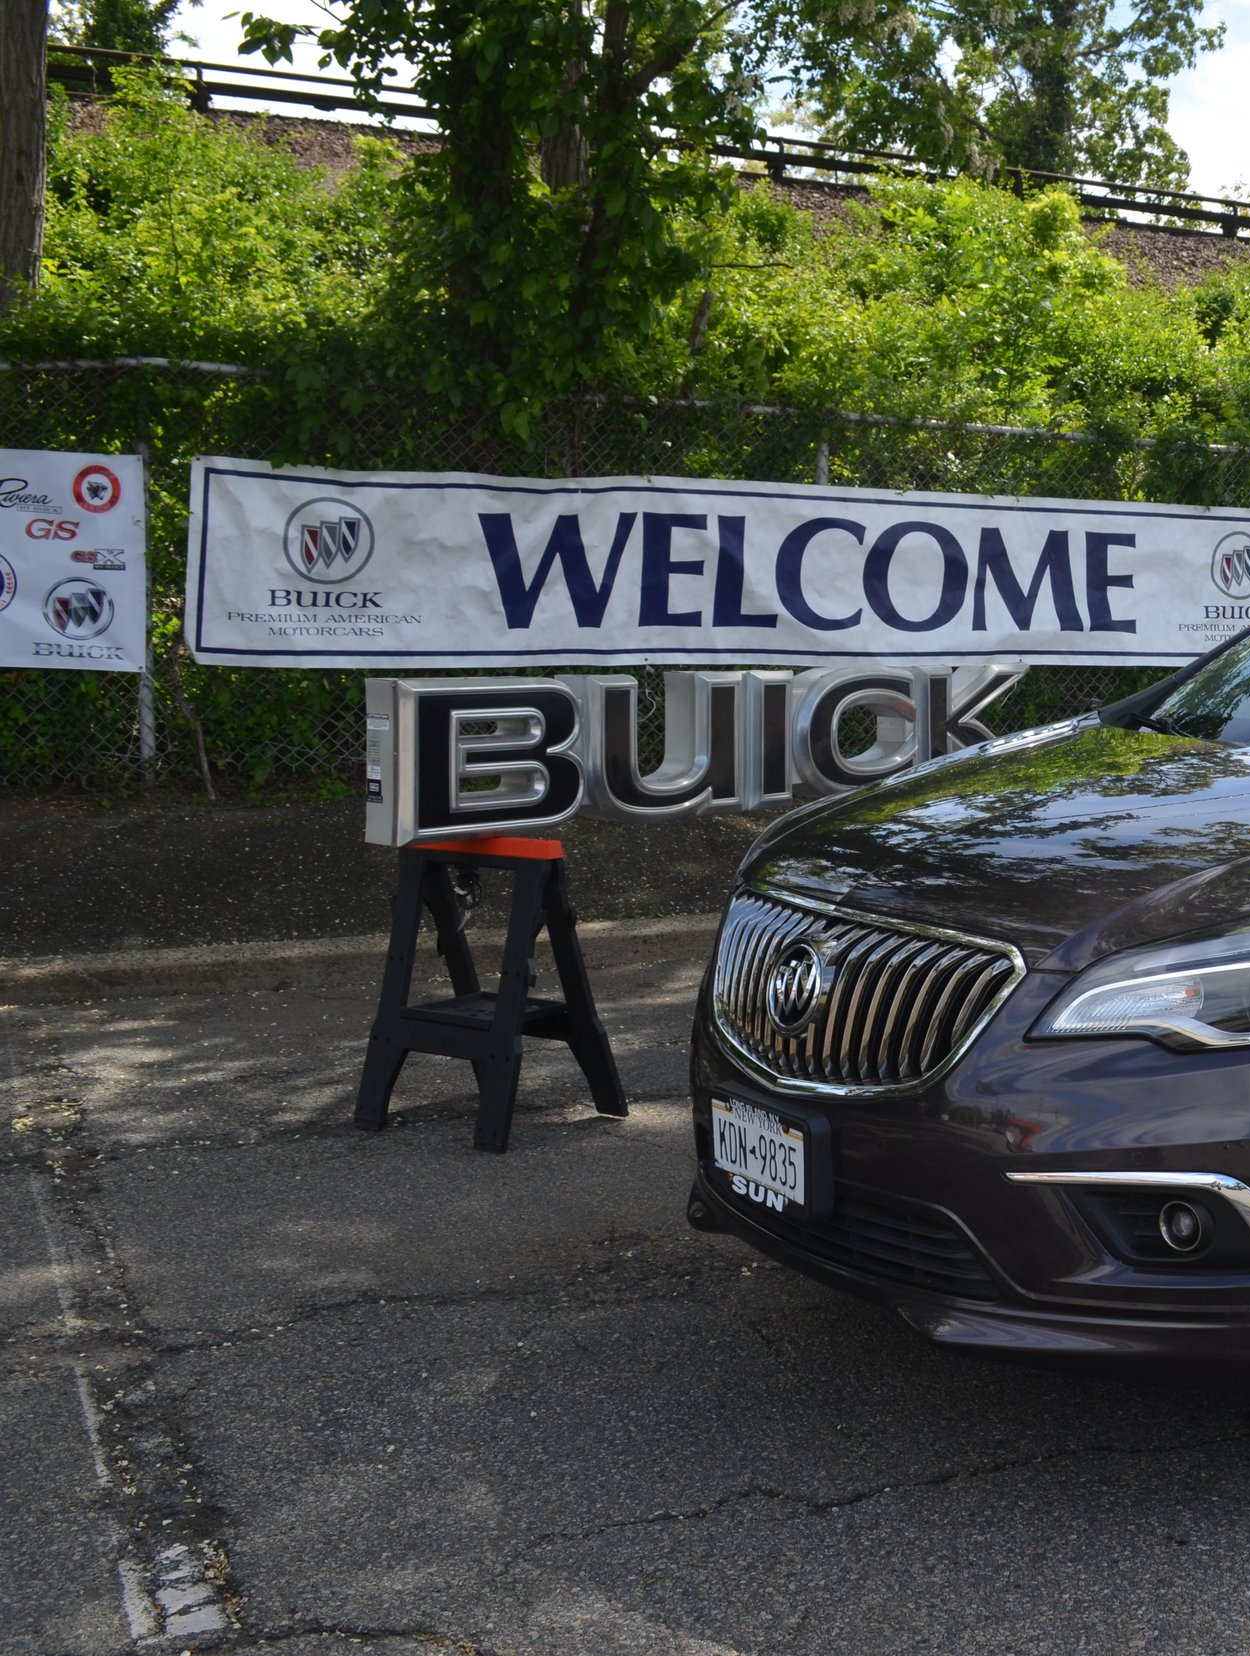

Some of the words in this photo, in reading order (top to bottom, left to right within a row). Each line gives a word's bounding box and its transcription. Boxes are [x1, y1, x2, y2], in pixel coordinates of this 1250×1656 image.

[25, 518, 80, 541] GS
[478, 512, 1137, 635] WELCOME
[268, 589, 383, 609] BUICK
[228, 611, 317, 623] PREMIUM
[325, 613, 422, 624] AMERICAN
[1178, 623, 1235, 632] PREMIUM
[268, 626, 384, 637] MOTORCARS
[32, 641, 125, 661] BUICK
[384, 665, 1027, 840] BUICK
[758, 1134, 797, 1190] 9835
[731, 1174, 784, 1213] SUN
